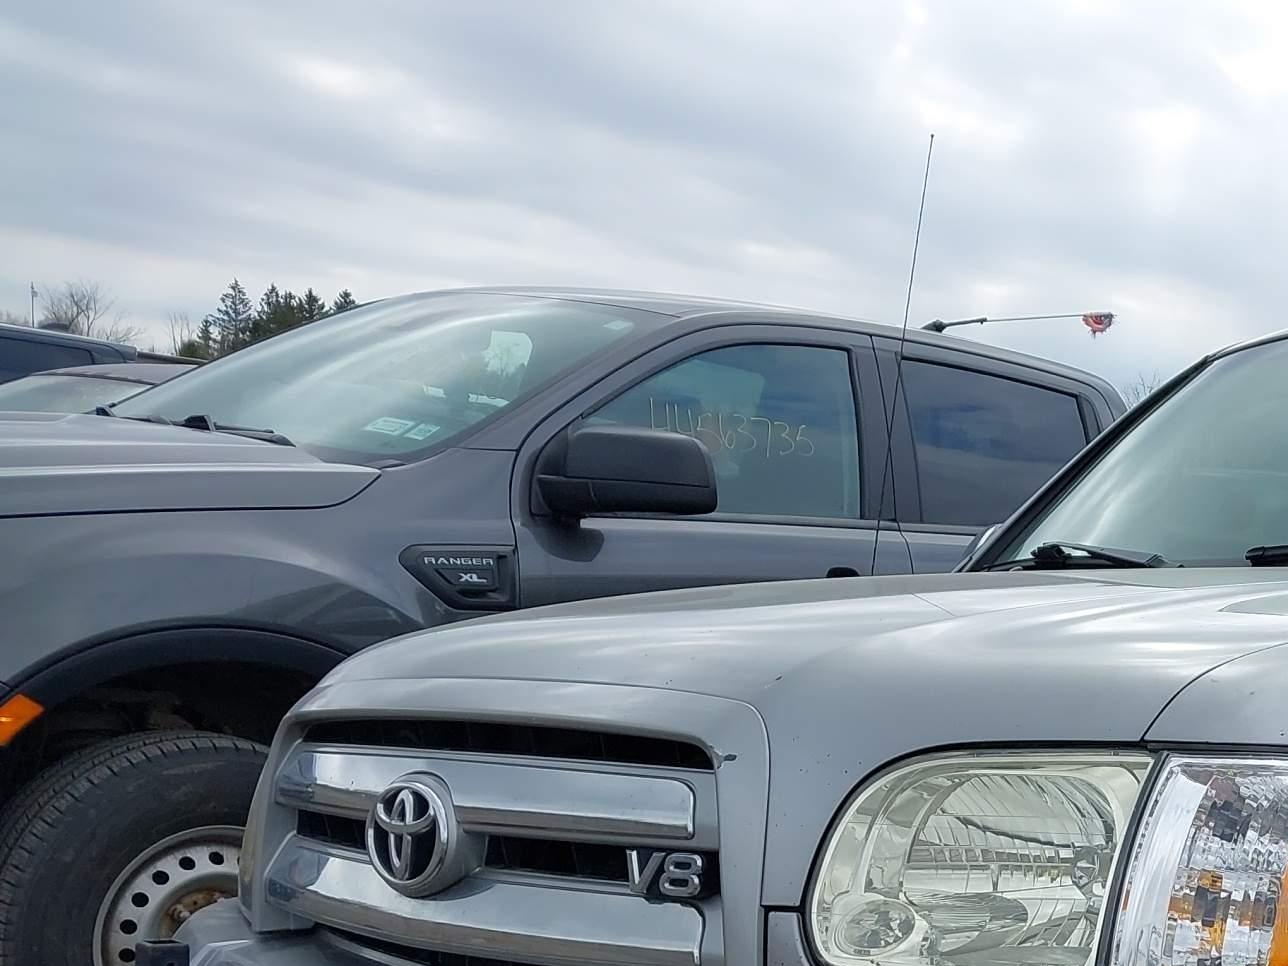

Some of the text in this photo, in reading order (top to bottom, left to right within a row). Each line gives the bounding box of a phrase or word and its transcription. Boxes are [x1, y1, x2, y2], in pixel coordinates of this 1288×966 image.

[424, 556, 494, 566] RANGER
[459, 573, 487, 583] XL
[625, 849, 703, 897] V8
